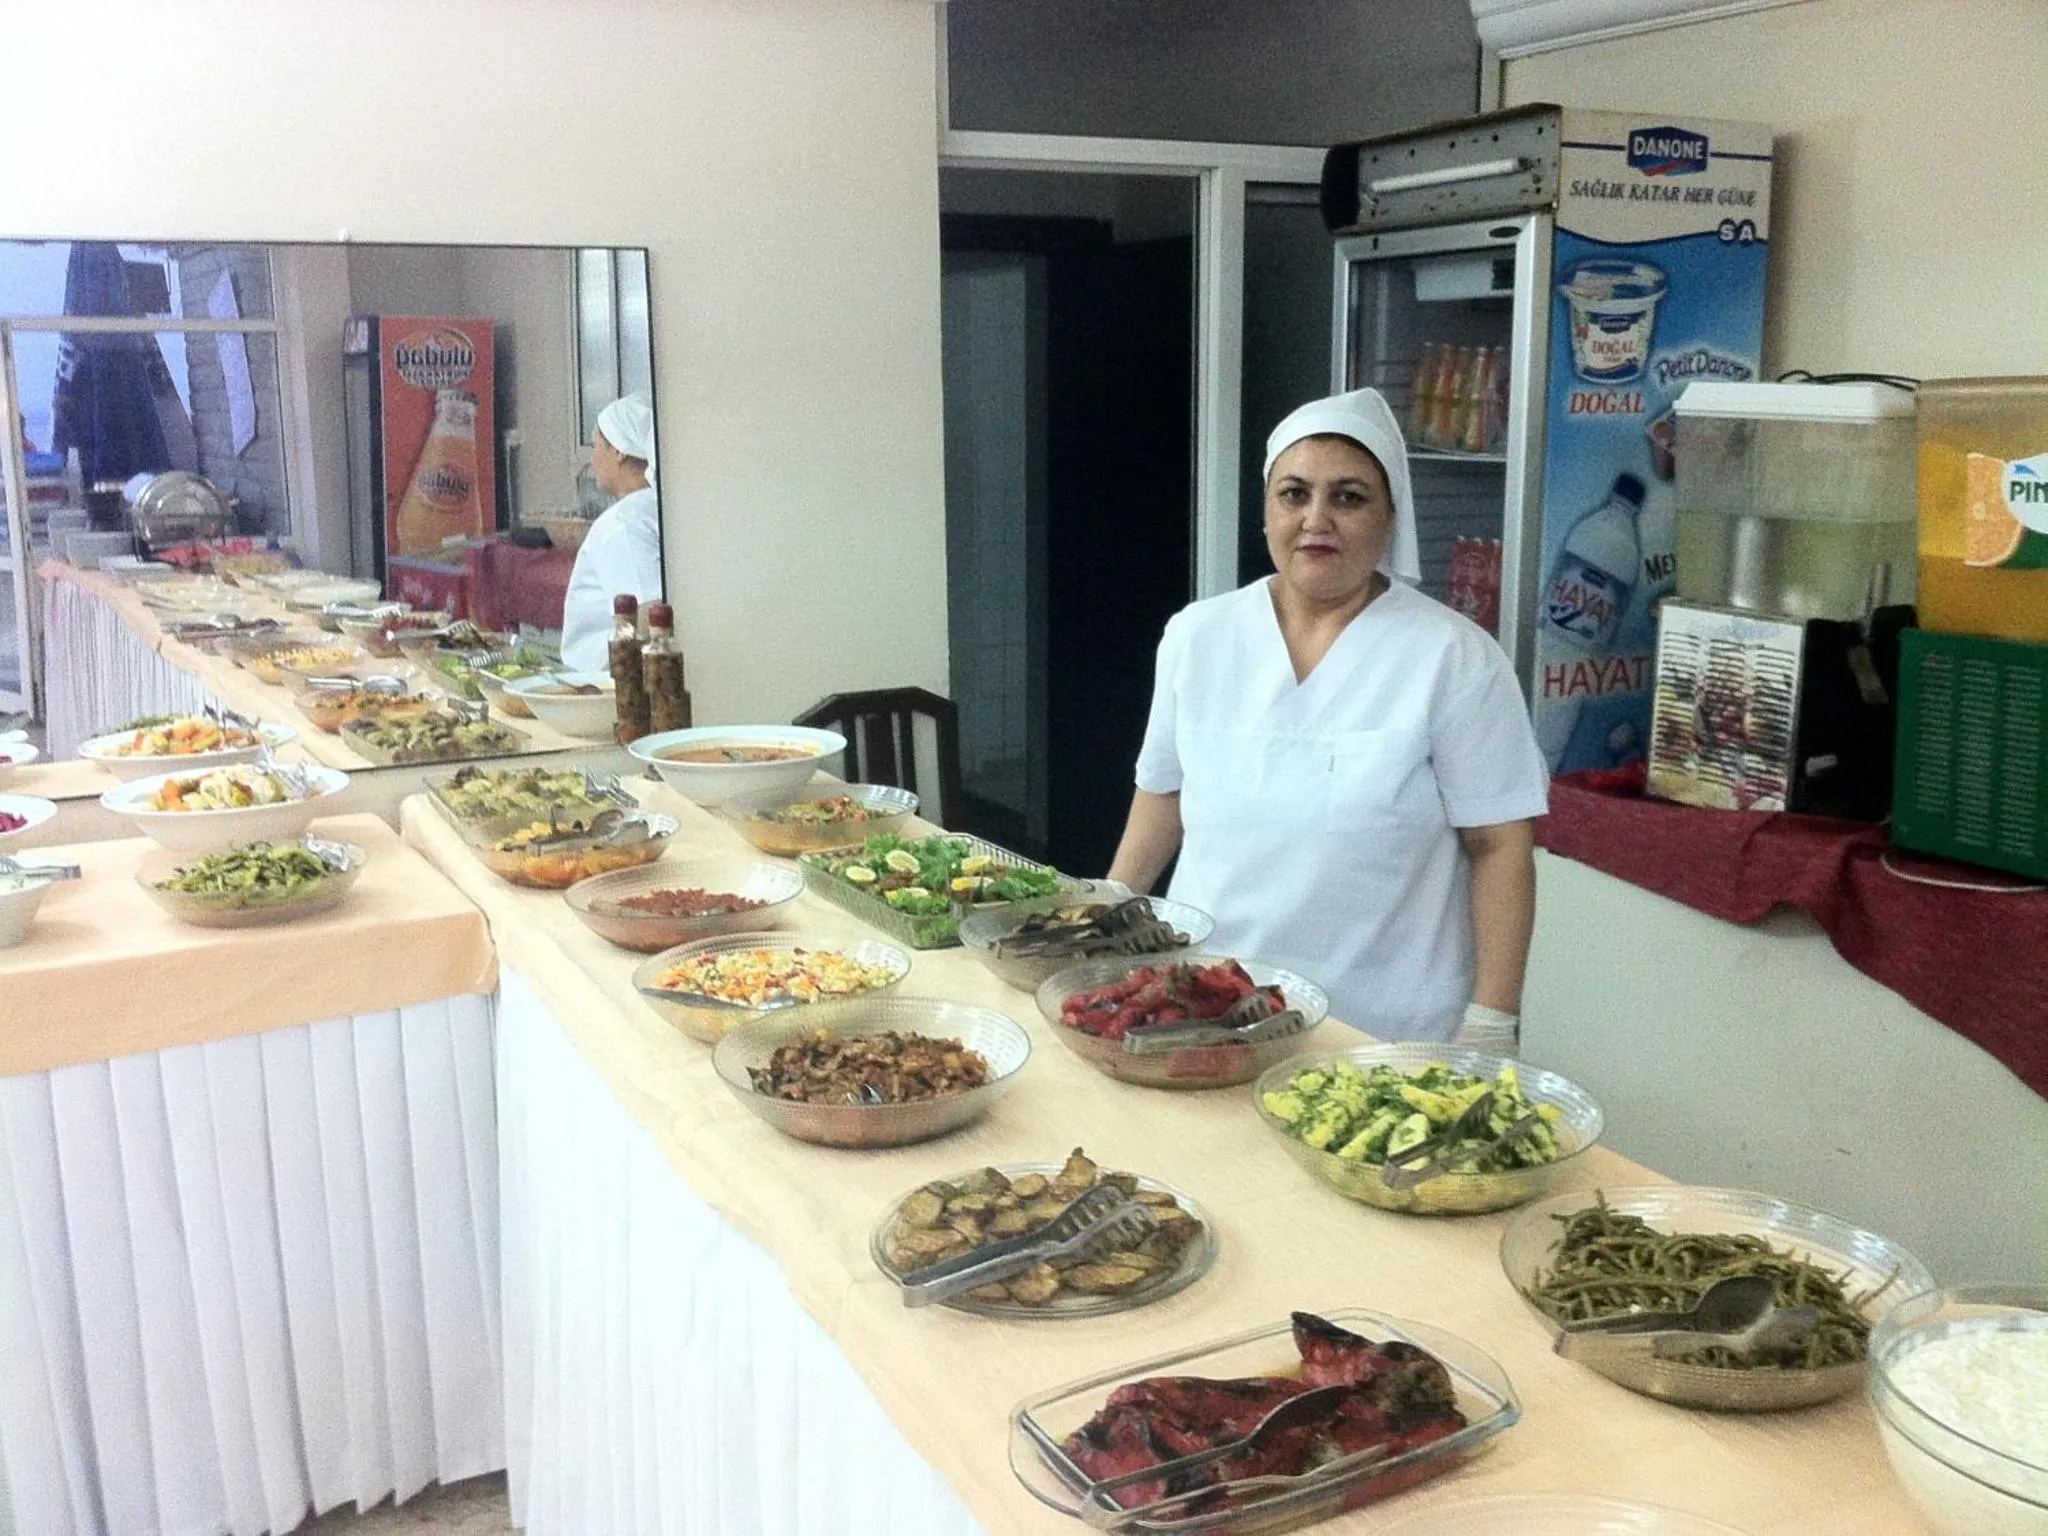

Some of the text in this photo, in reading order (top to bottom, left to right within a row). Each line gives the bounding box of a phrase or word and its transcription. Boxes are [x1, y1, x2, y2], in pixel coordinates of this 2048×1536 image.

[1633, 136, 1703, 160] DANONE
[1569, 179, 1624, 200] SAĞLIK
[1628, 183, 1680, 202] KATAR
[1683, 187, 1714, 205] HER
[1719, 222, 1755, 243] SA
[1570, 388, 1645, 414] DOĞAL
[1543, 655, 1650, 699] HAYAT
